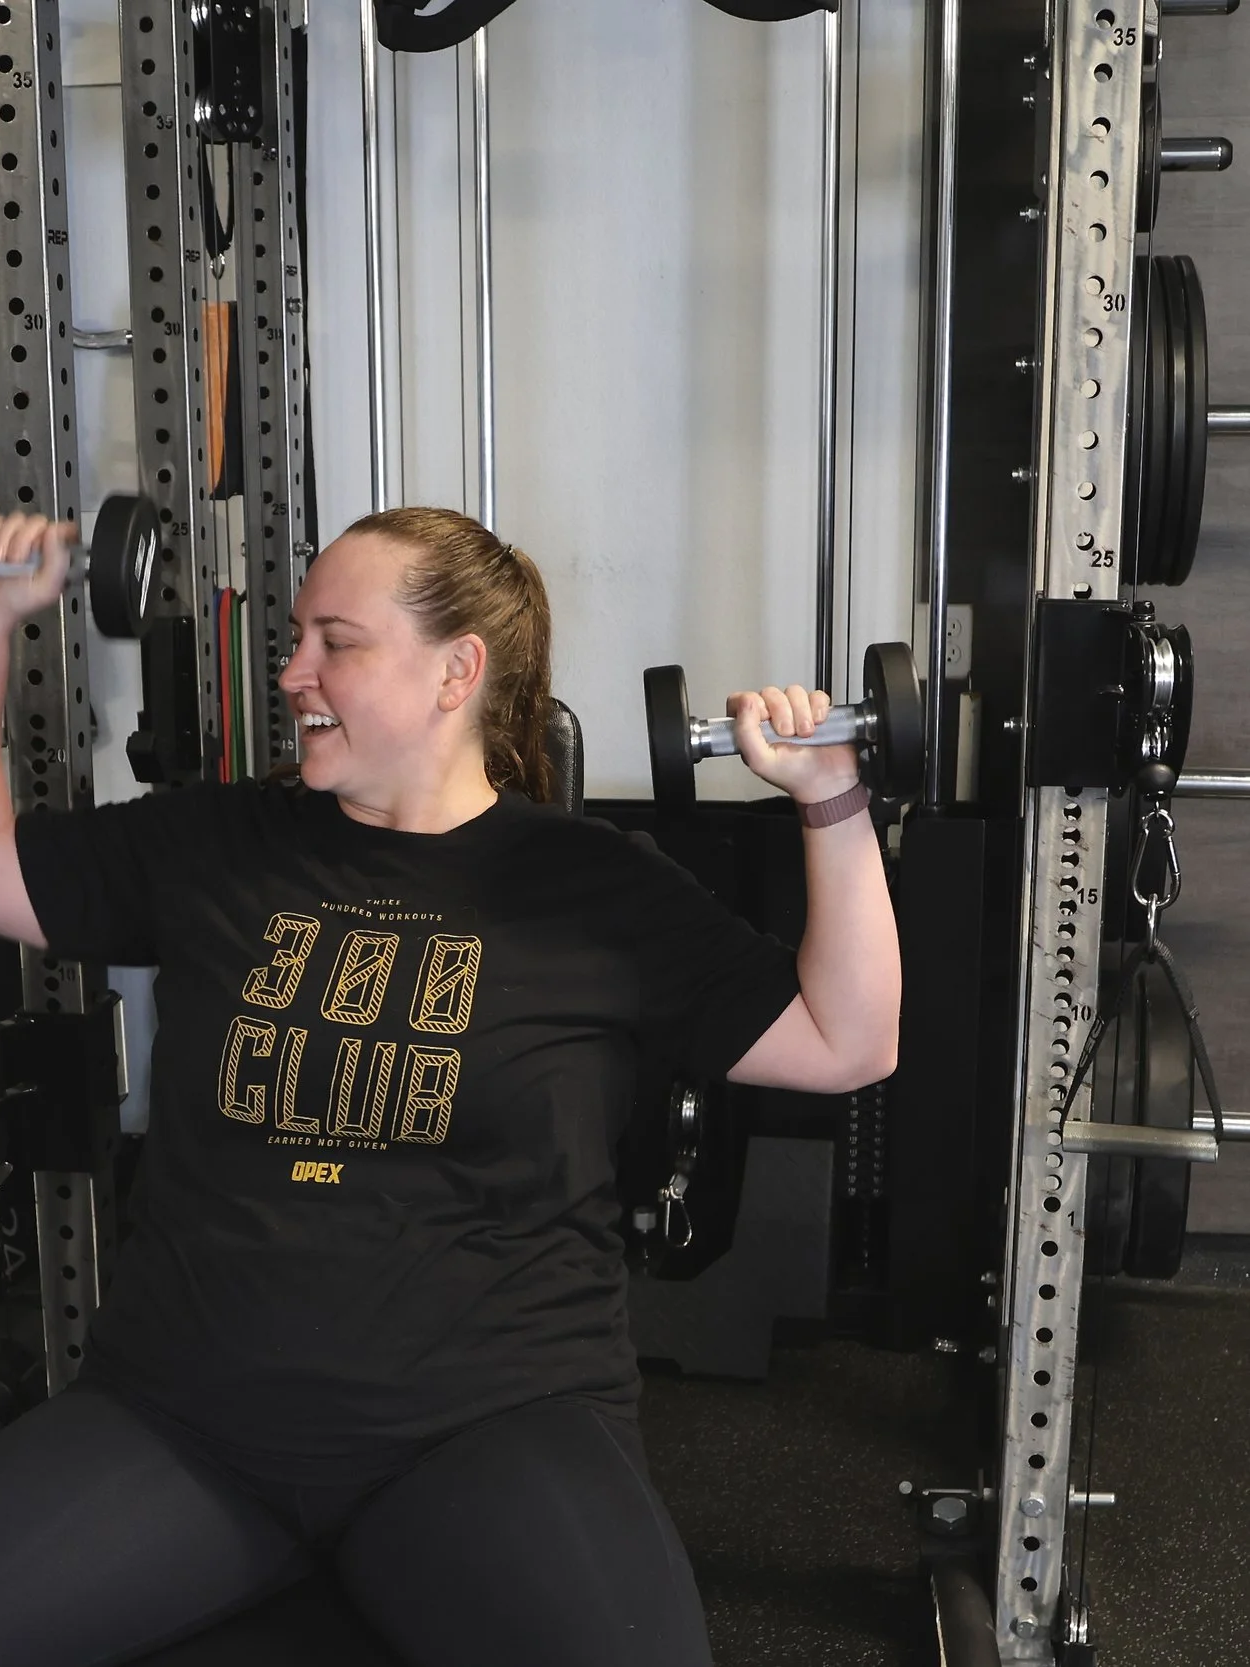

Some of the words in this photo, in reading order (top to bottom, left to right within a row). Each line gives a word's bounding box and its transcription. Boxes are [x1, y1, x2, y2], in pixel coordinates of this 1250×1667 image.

[1113, 27, 1137, 46] 35
[12, 71, 33, 88] 35
[156, 115, 174, 130] 35
[47, 229, 68, 246] REP
[1103, 293, 1126, 312] 30
[24, 313, 44, 332] 30
[164, 321, 182, 337] 30
[272, 503, 287, 516] 25
[171, 522, 188, 536] 25
[1091, 549, 1114, 569] 25
[47, 747, 67, 764] 20
[1076, 888, 1098, 905] 15
[321, 901, 373, 918] HUNDRED
[379, 912, 443, 922] WORKOUTS
[58, 966, 76, 982] 10
[242, 911, 483, 1035] 300
[1070, 1005, 1092, 1022] 10
[217, 1015, 462, 1146] CLUB
[267, 1135, 312, 1147] EARNED
[317, 1137, 343, 1149] NOT
[348, 1140, 389, 1151] GIVEN
[291, 1161, 344, 1184] OPEX
[1067, 1210, 1076, 1227] 1
